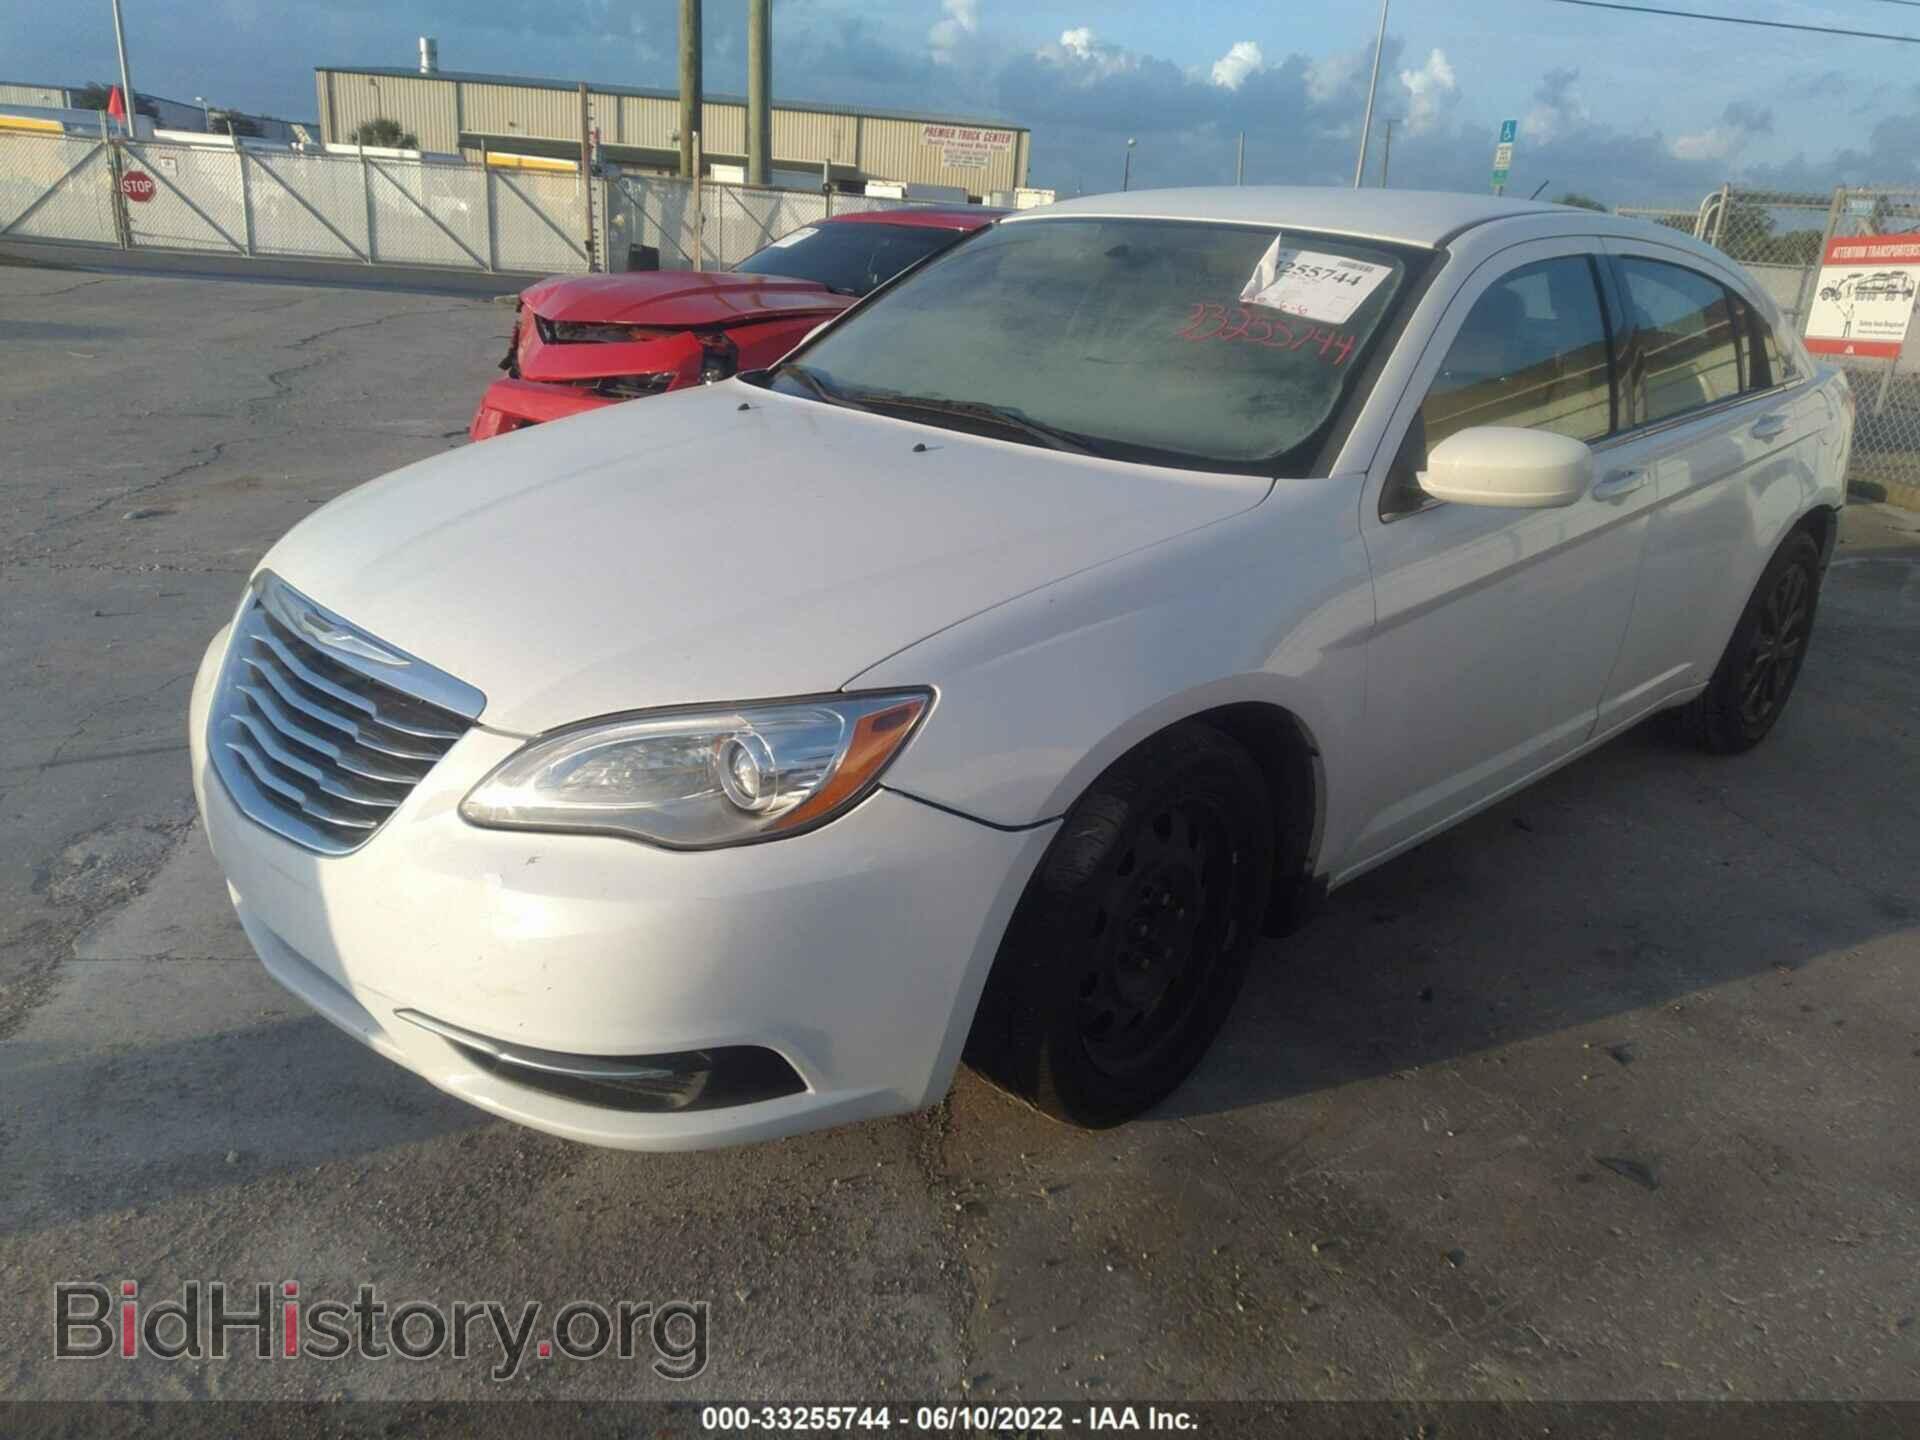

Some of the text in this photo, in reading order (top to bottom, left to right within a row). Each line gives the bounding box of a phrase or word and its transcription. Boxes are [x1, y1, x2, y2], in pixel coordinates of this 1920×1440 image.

[924, 126, 1011, 144] PREMIER TRUCK CENTER
[123, 180, 152, 193] STOP
